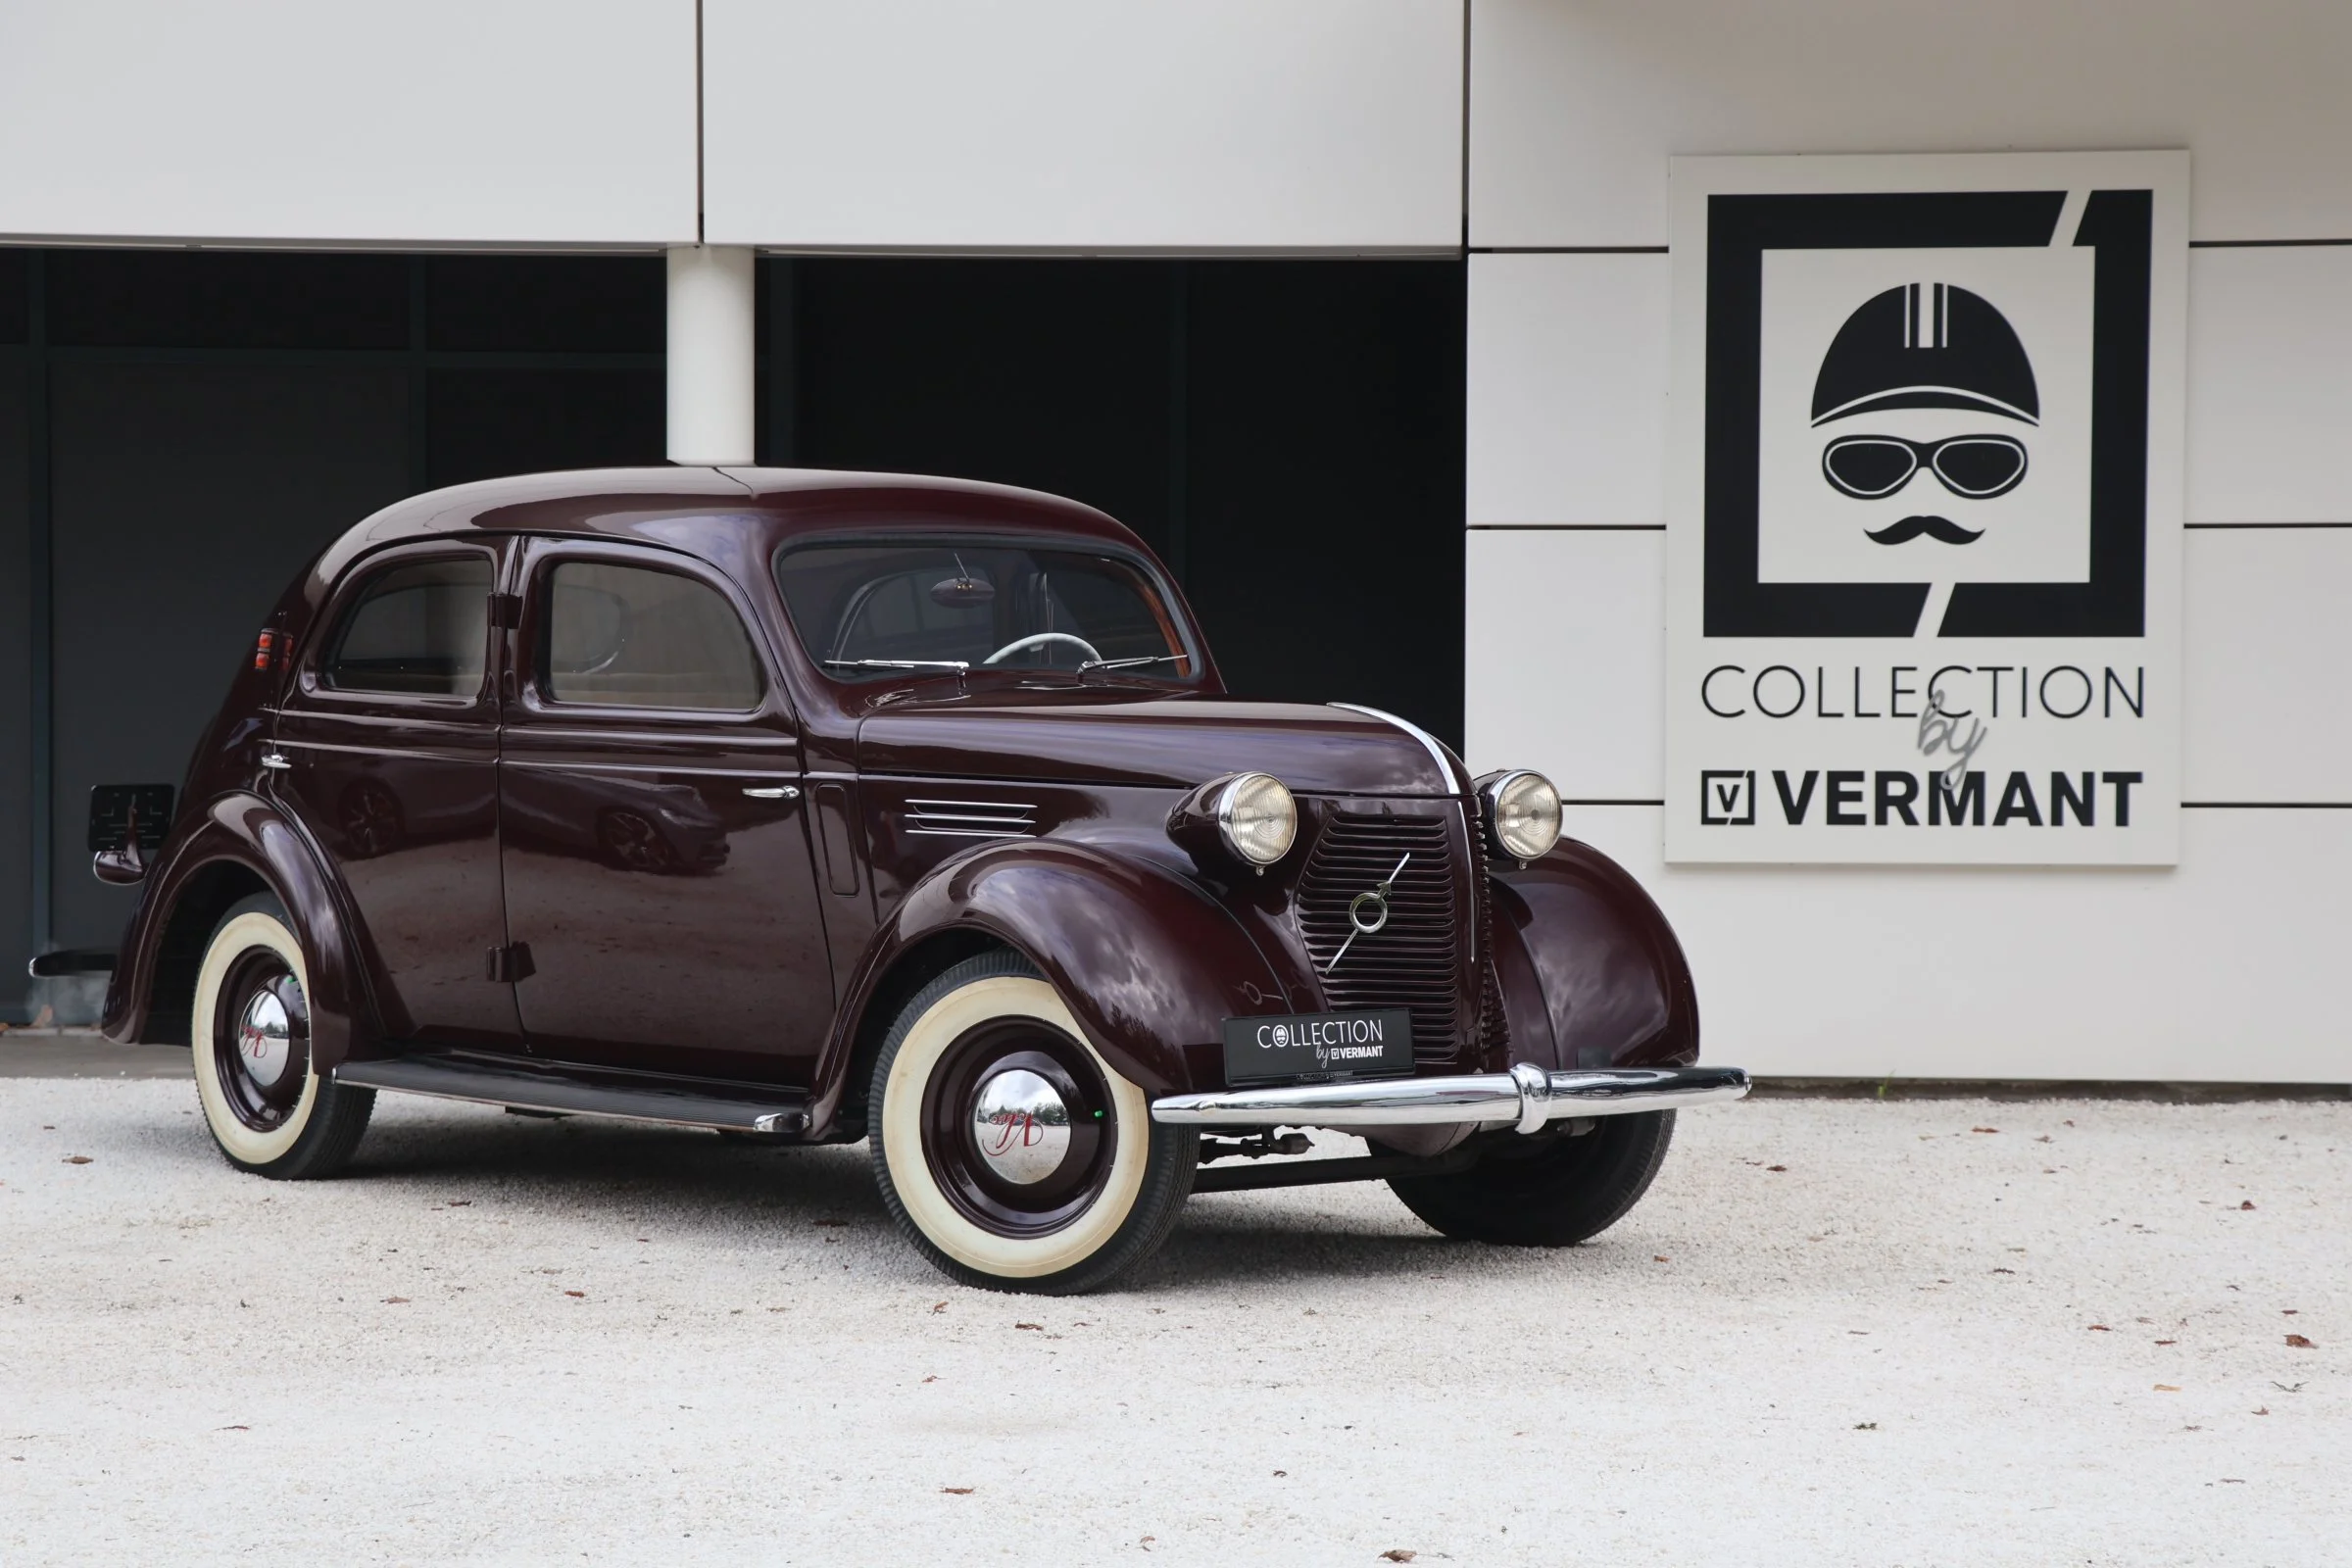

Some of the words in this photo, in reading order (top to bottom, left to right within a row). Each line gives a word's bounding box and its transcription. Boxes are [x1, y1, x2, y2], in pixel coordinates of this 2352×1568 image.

[1701, 664, 2144, 719] COLLECTION
[1917, 688, 1988, 792] by
[1771, 769, 2143, 827] VERMANT
[1256, 1018, 1383, 1049] COLLECTION
[1316, 1041, 1331, 1069] by
[1339, 1045, 1384, 1059] VERMANT
